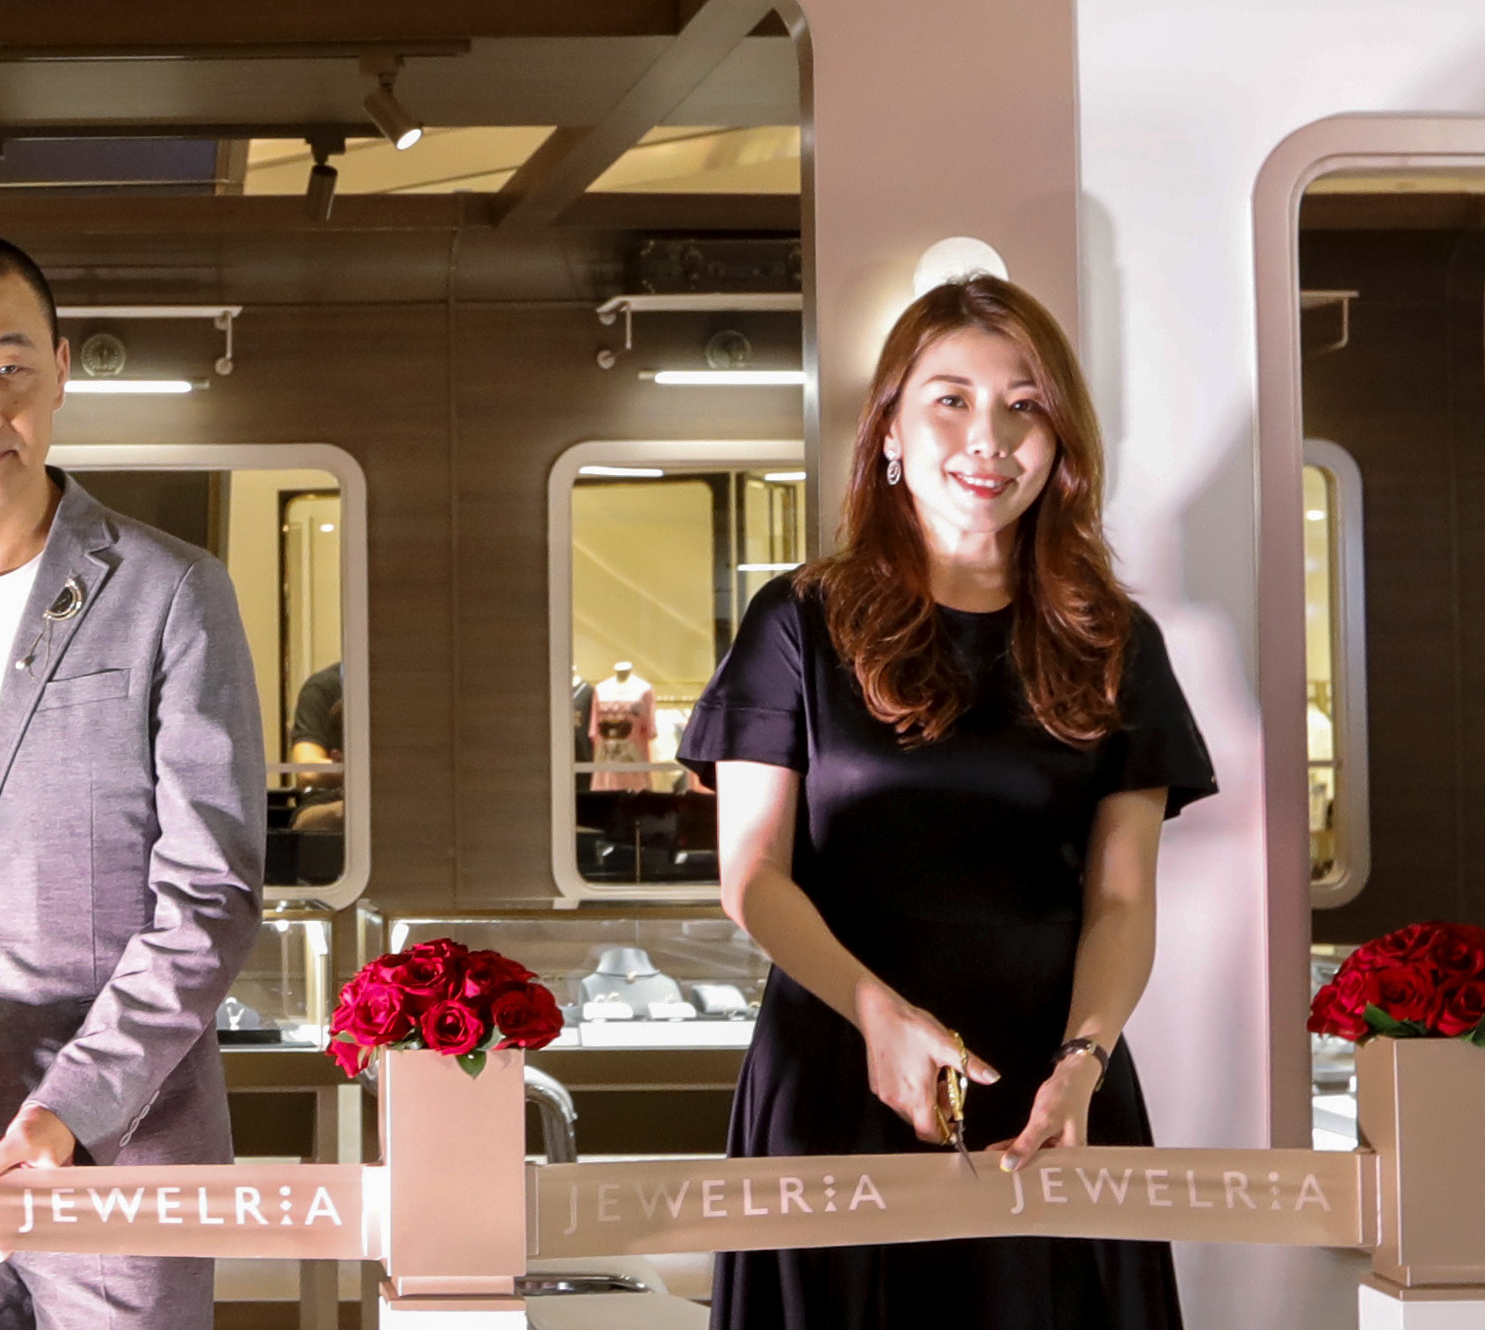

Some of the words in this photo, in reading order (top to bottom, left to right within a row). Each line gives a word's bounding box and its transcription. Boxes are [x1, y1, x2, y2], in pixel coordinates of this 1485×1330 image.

[18, 1185, 342, 1233] JEWELRIA
[563, 1173, 886, 1236] JEWELRIA
[1010, 1167, 1331, 1214] JEWELRIA
